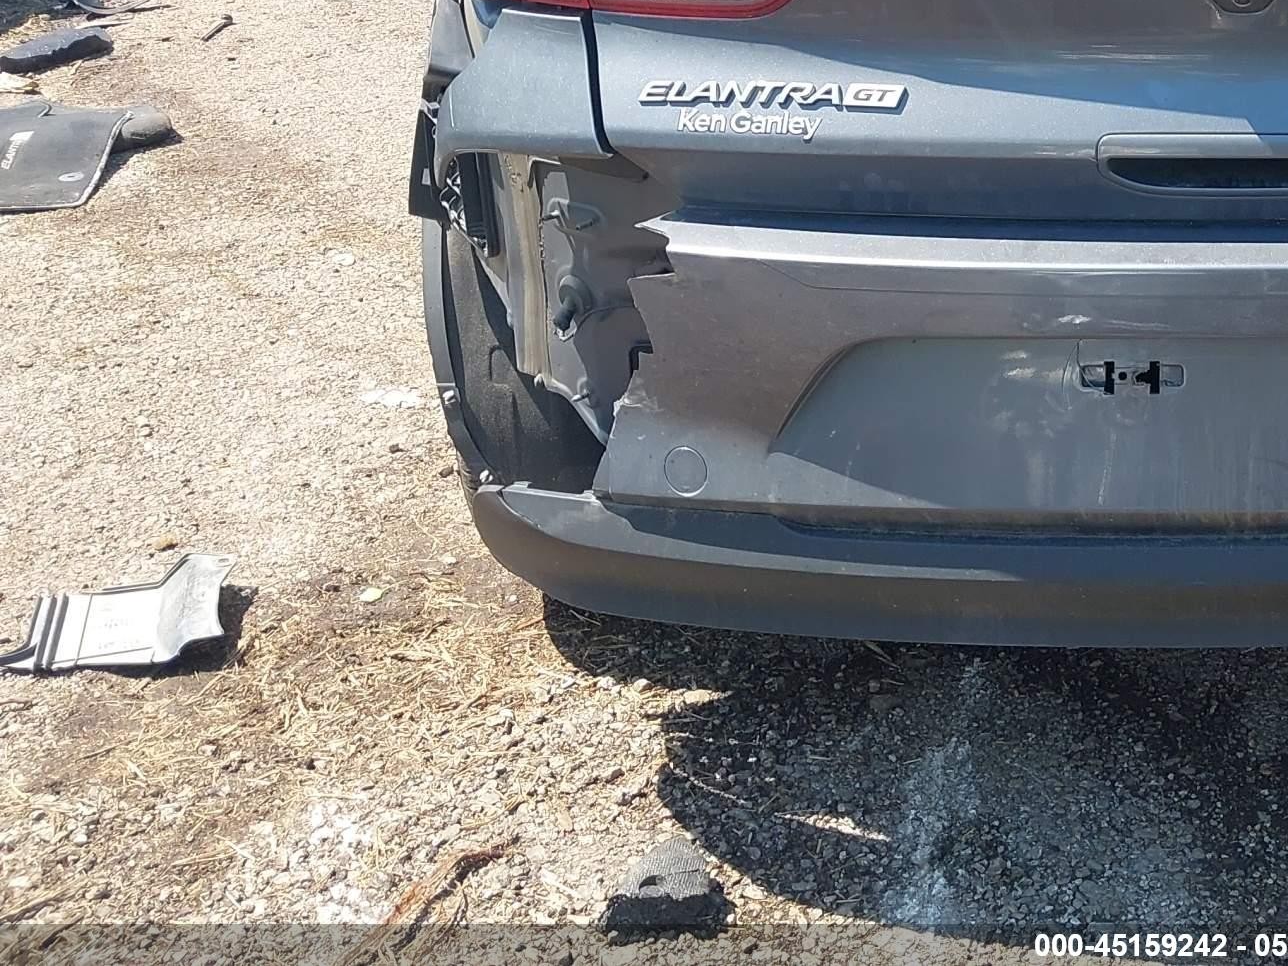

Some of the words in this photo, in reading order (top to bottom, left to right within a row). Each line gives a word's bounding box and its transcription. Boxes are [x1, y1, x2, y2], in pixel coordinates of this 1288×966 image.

[638, 80, 843, 107] ELANTRA
[677, 109, 726, 133] Ken
[729, 111, 823, 142] Ganley
